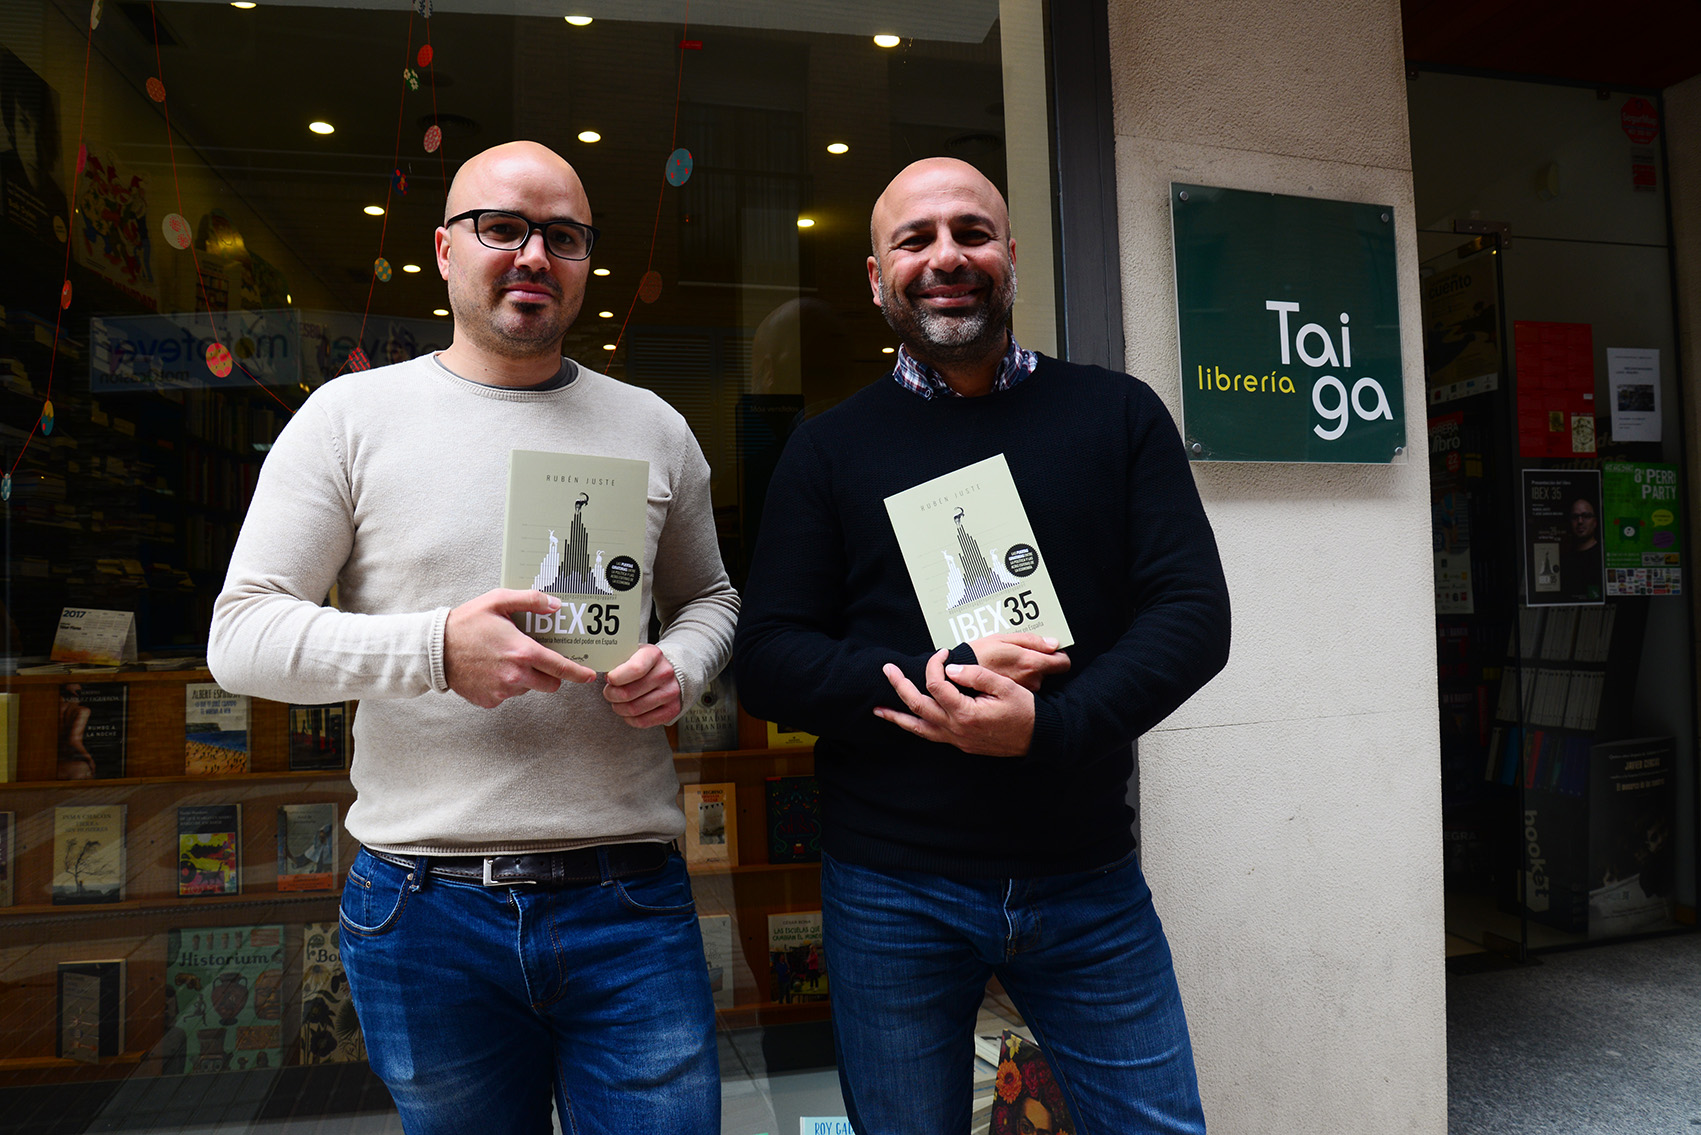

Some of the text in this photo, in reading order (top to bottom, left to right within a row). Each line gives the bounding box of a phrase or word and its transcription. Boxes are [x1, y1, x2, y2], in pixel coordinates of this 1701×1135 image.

[1429, 275, 1472, 298] cuento
[1266, 300, 1352, 368] Tai
[1198, 365, 1296, 394] librería
[1312, 376, 1394, 441] ga
[546, 474, 615, 486] RUBÉN JUSTE
[920, 484, 982, 512] RUBÉN JUSTE
[1532, 486, 1562, 500] IBEX 35
[1642, 484, 1676, 500] PARTY
[63, 610, 87, 618] 2017
[602, 638, 618, 646] España
[1444, 832, 1477, 841] EGRA
[1524, 810, 1550, 897] booket
[179, 952, 270, 967] Historium
[815, 1122, 833, 1135] ROY
